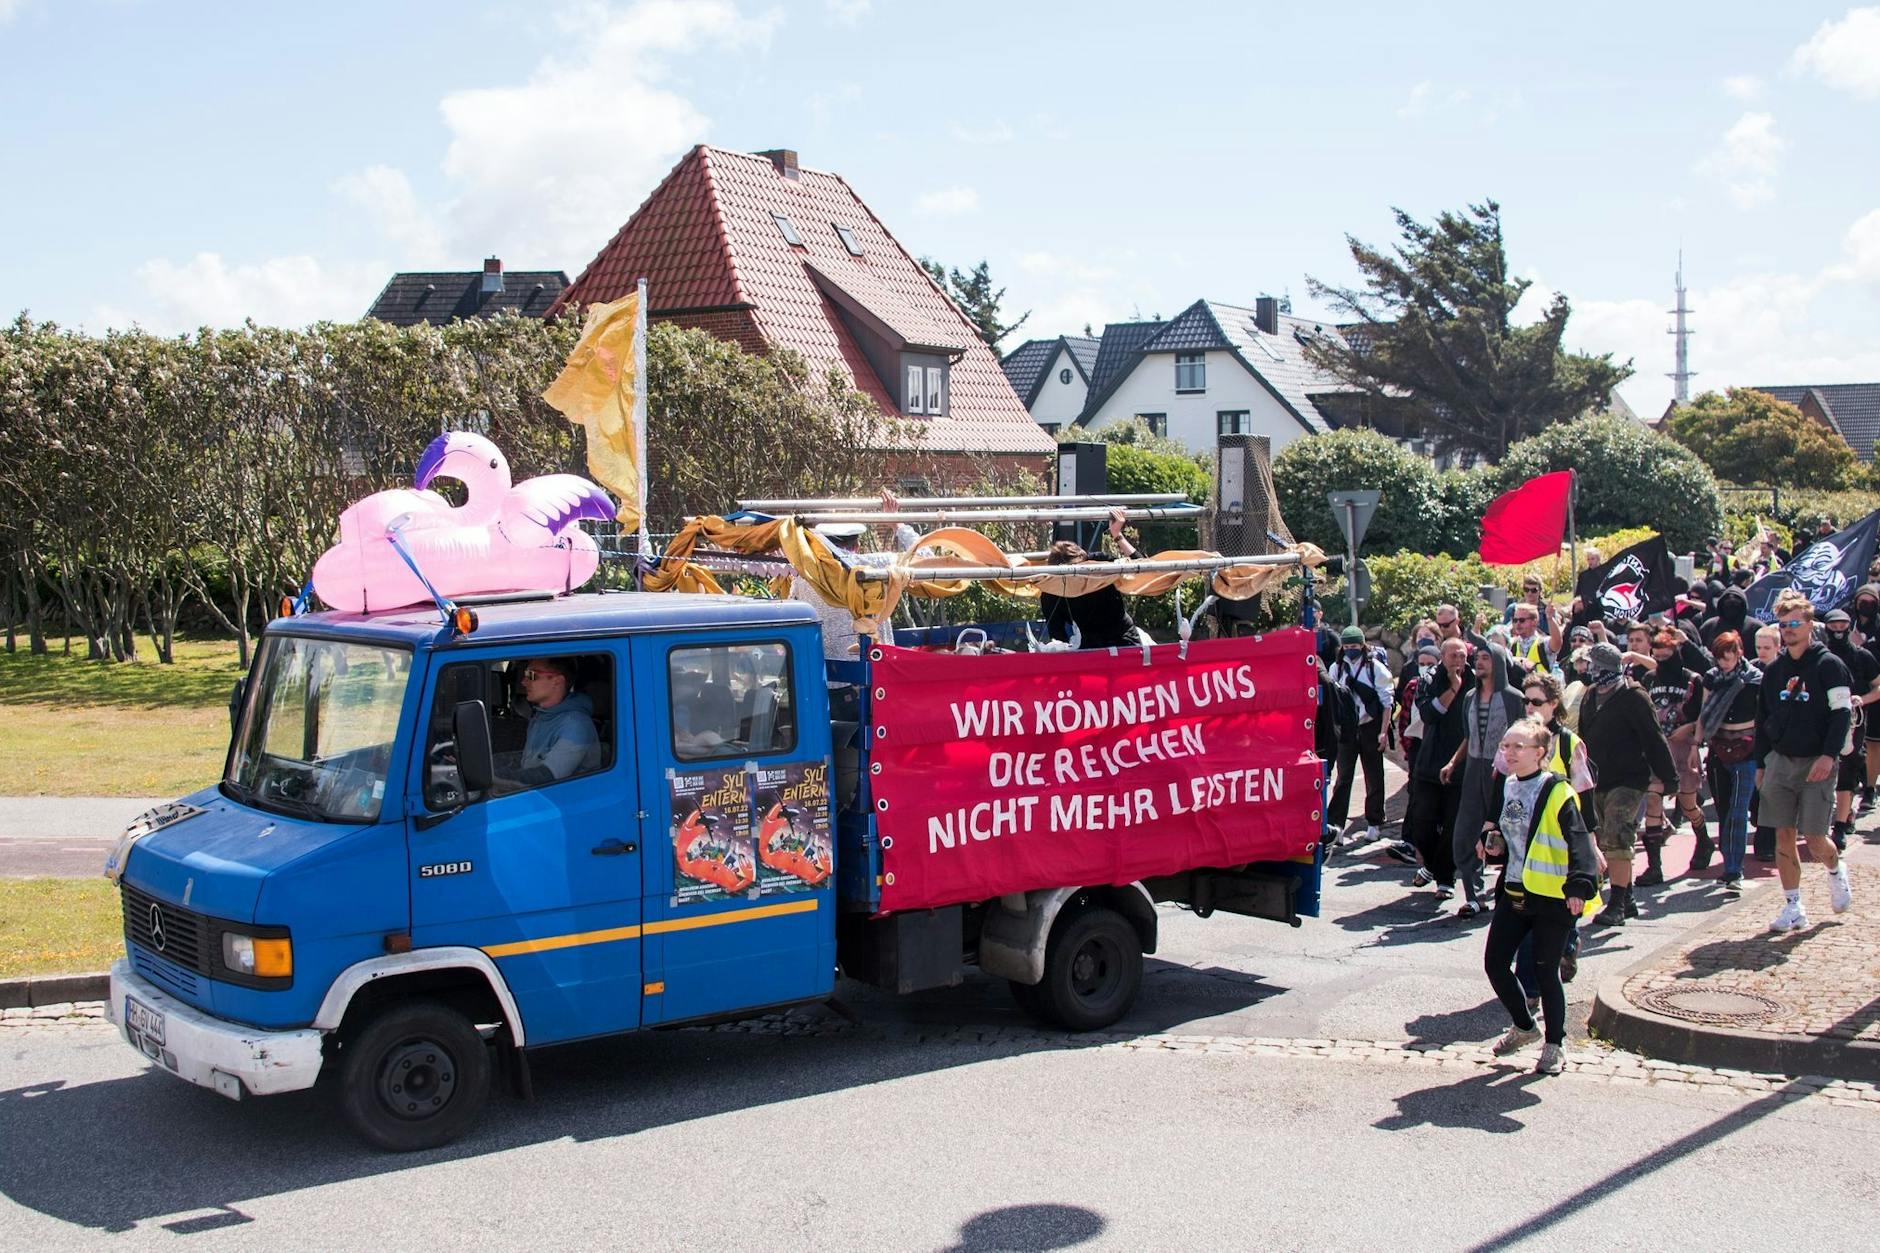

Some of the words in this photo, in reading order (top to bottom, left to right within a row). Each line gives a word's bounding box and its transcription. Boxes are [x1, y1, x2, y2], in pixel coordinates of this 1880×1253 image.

[950, 697, 1025, 739] WIR
[1034, 679, 1181, 736] KÖNNEN
[1187, 665, 1256, 708] UNS
[988, 751, 1047, 787] DIE
[1054, 723, 1206, 784] REICHEN
[723, 771, 747, 792] SYLT
[804, 765, 827, 786] SYLT
[702, 787, 747, 807] ENTERN
[783, 782, 826, 800] ENTERN
[927, 796, 1038, 854] NICHT
[1050, 787, 1159, 832] MEHR
[1170, 767, 1284, 815] LEISTEN
